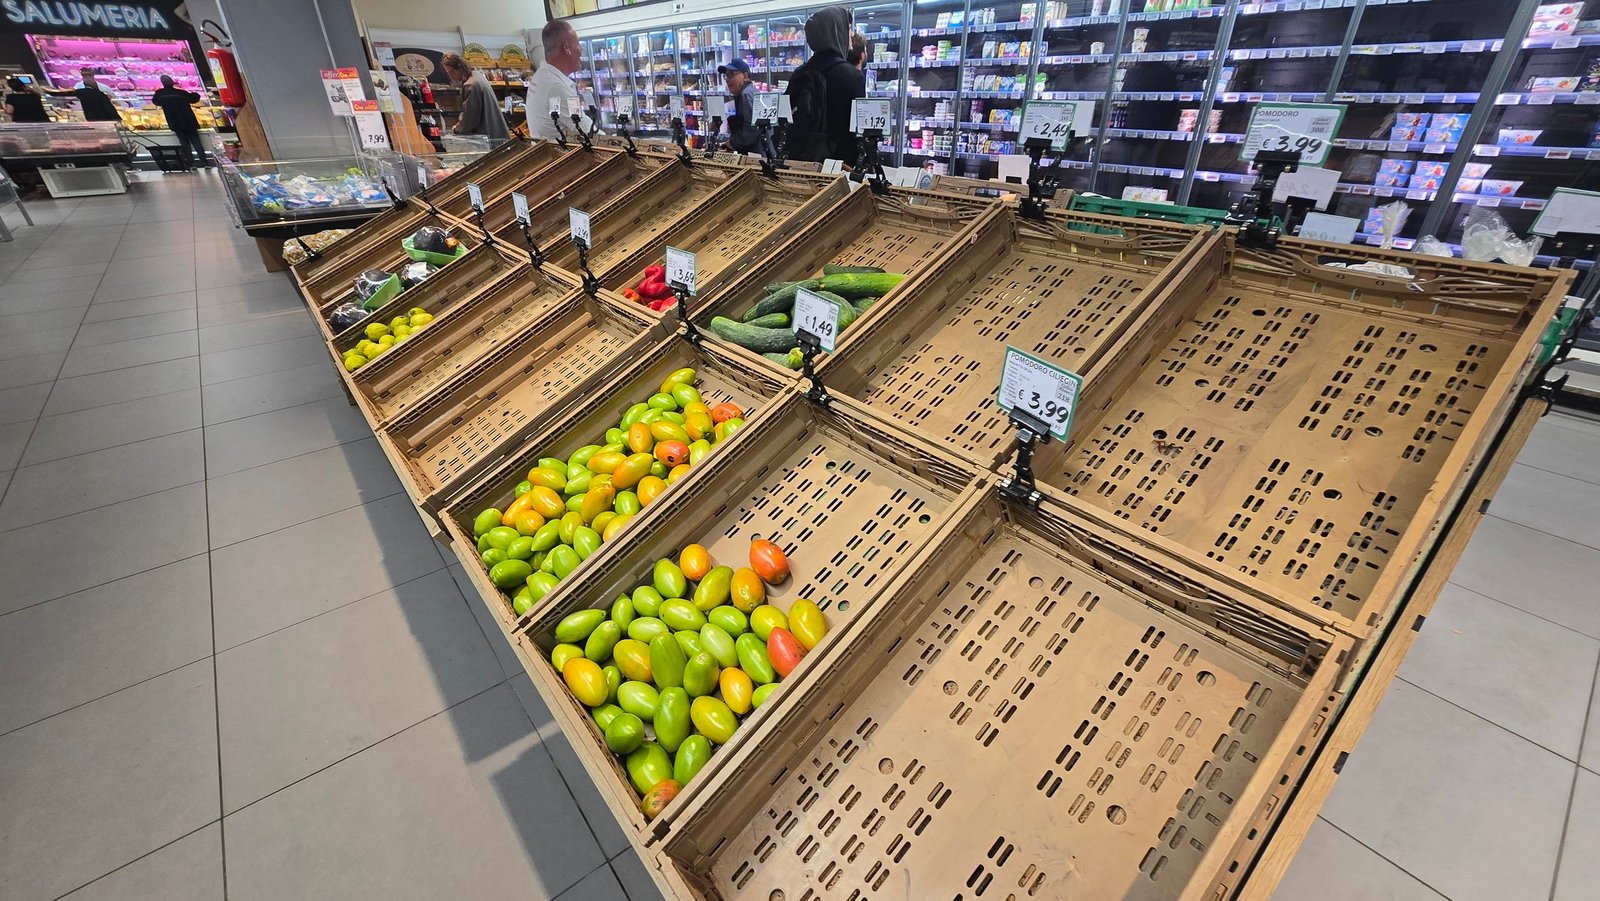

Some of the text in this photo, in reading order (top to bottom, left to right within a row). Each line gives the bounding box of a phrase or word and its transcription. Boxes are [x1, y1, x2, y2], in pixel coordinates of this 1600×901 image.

[2, 0, 169, 29] SALUMERIA
[762, 107, 777, 118] 3,29
[870, 116, 886, 128] 1,79
[1033, 122, 1069, 138] € 2,49
[368, 134, 384, 144] 7,99
[1262, 138, 1271, 149] €
[1274, 135, 1323, 154] 3,99
[677, 268, 694, 284] 3,69
[811, 315, 833, 336] 1,49
[1010, 353, 1048, 375] POMODORO
[1018, 389, 1069, 424] € 3,99
